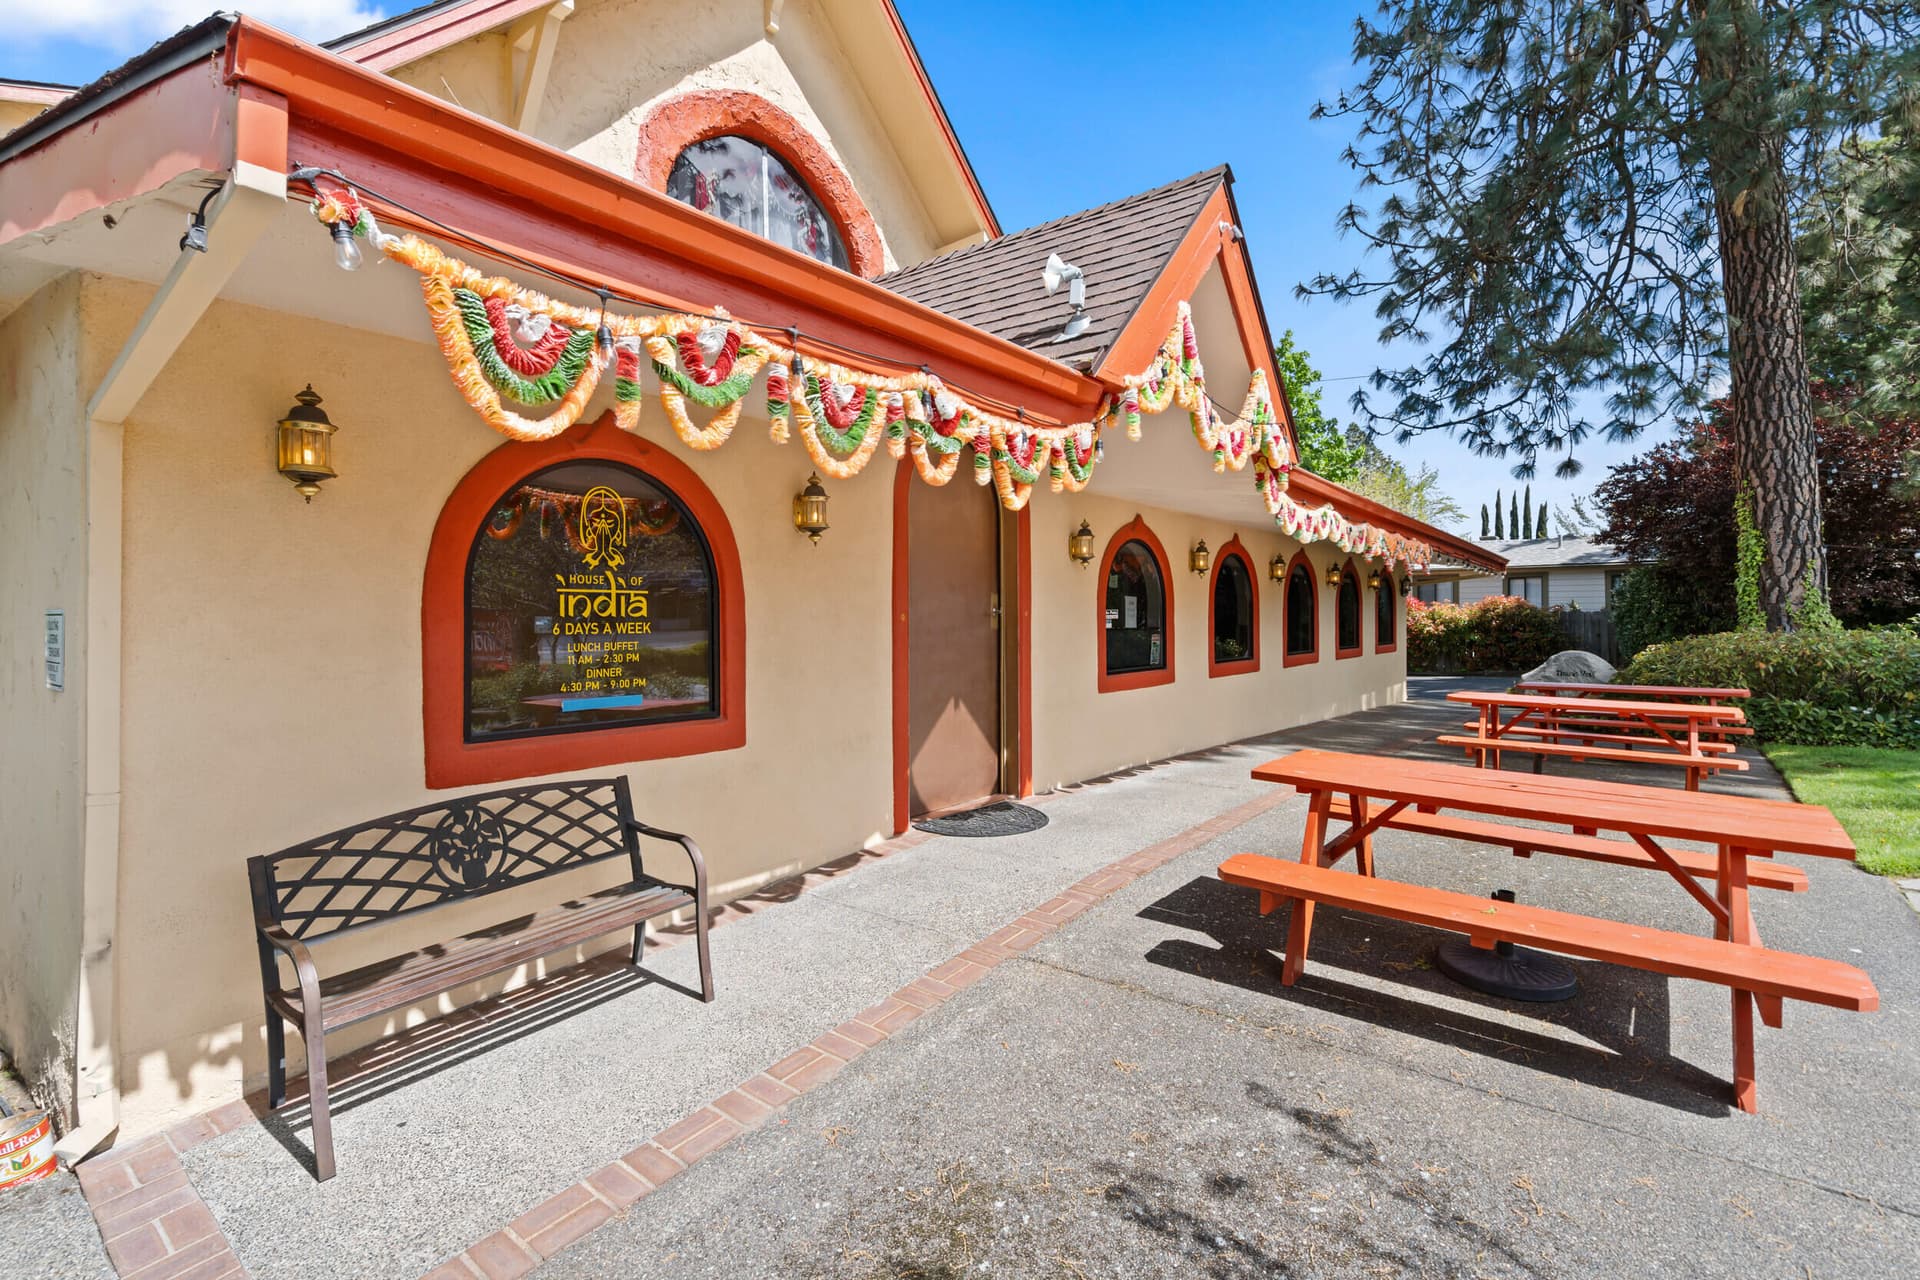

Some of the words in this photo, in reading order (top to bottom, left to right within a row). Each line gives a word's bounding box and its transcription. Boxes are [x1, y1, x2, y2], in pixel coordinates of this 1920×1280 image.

[569, 574, 605, 585] HOUSE
[630, 576, 643, 586] OF
[552, 623, 560, 635] 6
[565, 622, 599, 635] DAYS
[602, 622, 612, 635] A
[615, 621, 652, 634] WEEK
[567, 642, 601, 653] LUNCH
[603, 641, 639, 651] BUFFET
[568, 655, 575, 665] 11
[578, 655, 593, 664] AM
[603, 653, 624, 664] 2:30
[626, 653, 640, 662] PM
[586, 667, 622, 679] DINNER
[560, 682, 582, 692] 4:30
[585, 681, 600, 691] PM
[610, 679, 630, 689] 9:00
[633, 678, 647, 687] PM
[0, 1127, 42, 1155] ull-Red
